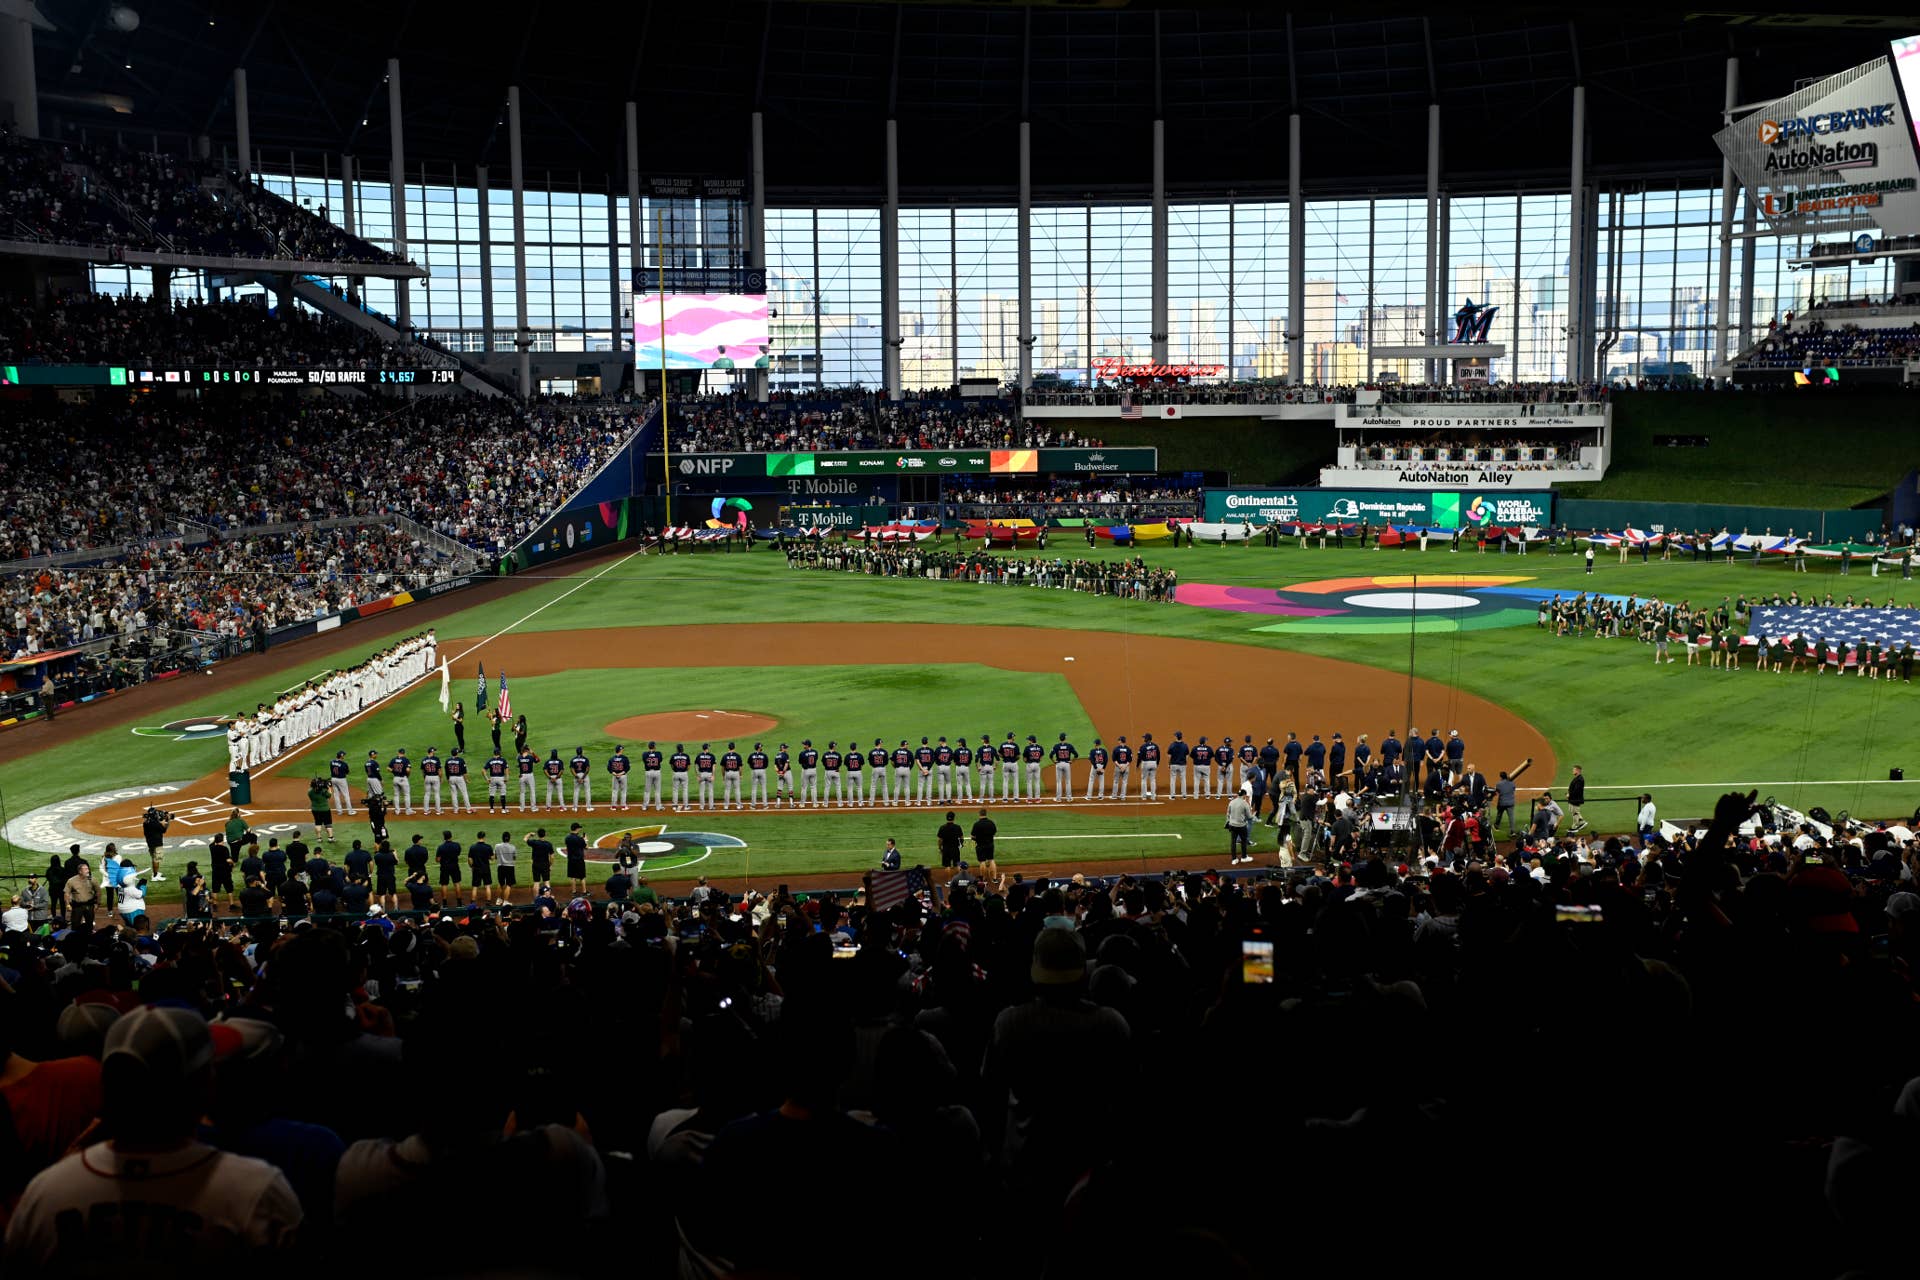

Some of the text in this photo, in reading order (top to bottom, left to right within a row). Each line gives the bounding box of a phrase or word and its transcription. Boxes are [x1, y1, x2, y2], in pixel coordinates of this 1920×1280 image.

[1764, 141, 1873, 171] AutoNation
[1800, 187, 1856, 200] UNIVERSITY
[1875, 178, 1912, 191] MIAMI
[1764, 192, 1795, 215] U
[1797, 194, 1879, 213] HEALTH SYSTEM
[1857, 238, 1871, 249] 42
[1091, 356, 1225, 380] Budweiser
[203, 372, 211, 381] B
[223, 372, 230, 381] S
[242, 372, 250, 381] O
[308, 370, 365, 384] 50/50 RAFFLE
[389, 371, 415, 384] 4,657
[432, 371, 455, 383] 7:04
[1363, 418, 1401, 426] AutoNation
[697, 459, 733, 474] NFP
[1074, 462, 1119, 471] Budweiser
[1399, 472, 1513, 485] AutoNation Alley
[805, 478, 858, 494] Mobile
[1225, 494, 1288, 509] Continental
[1360, 502, 1426, 512] Dominican Republic
[1497, 500, 1531, 508] WORLD
[1497, 507, 1543, 515] BASEBALL
[812, 512, 853, 525] Mobile
[1650, 524, 1664, 533] 400
